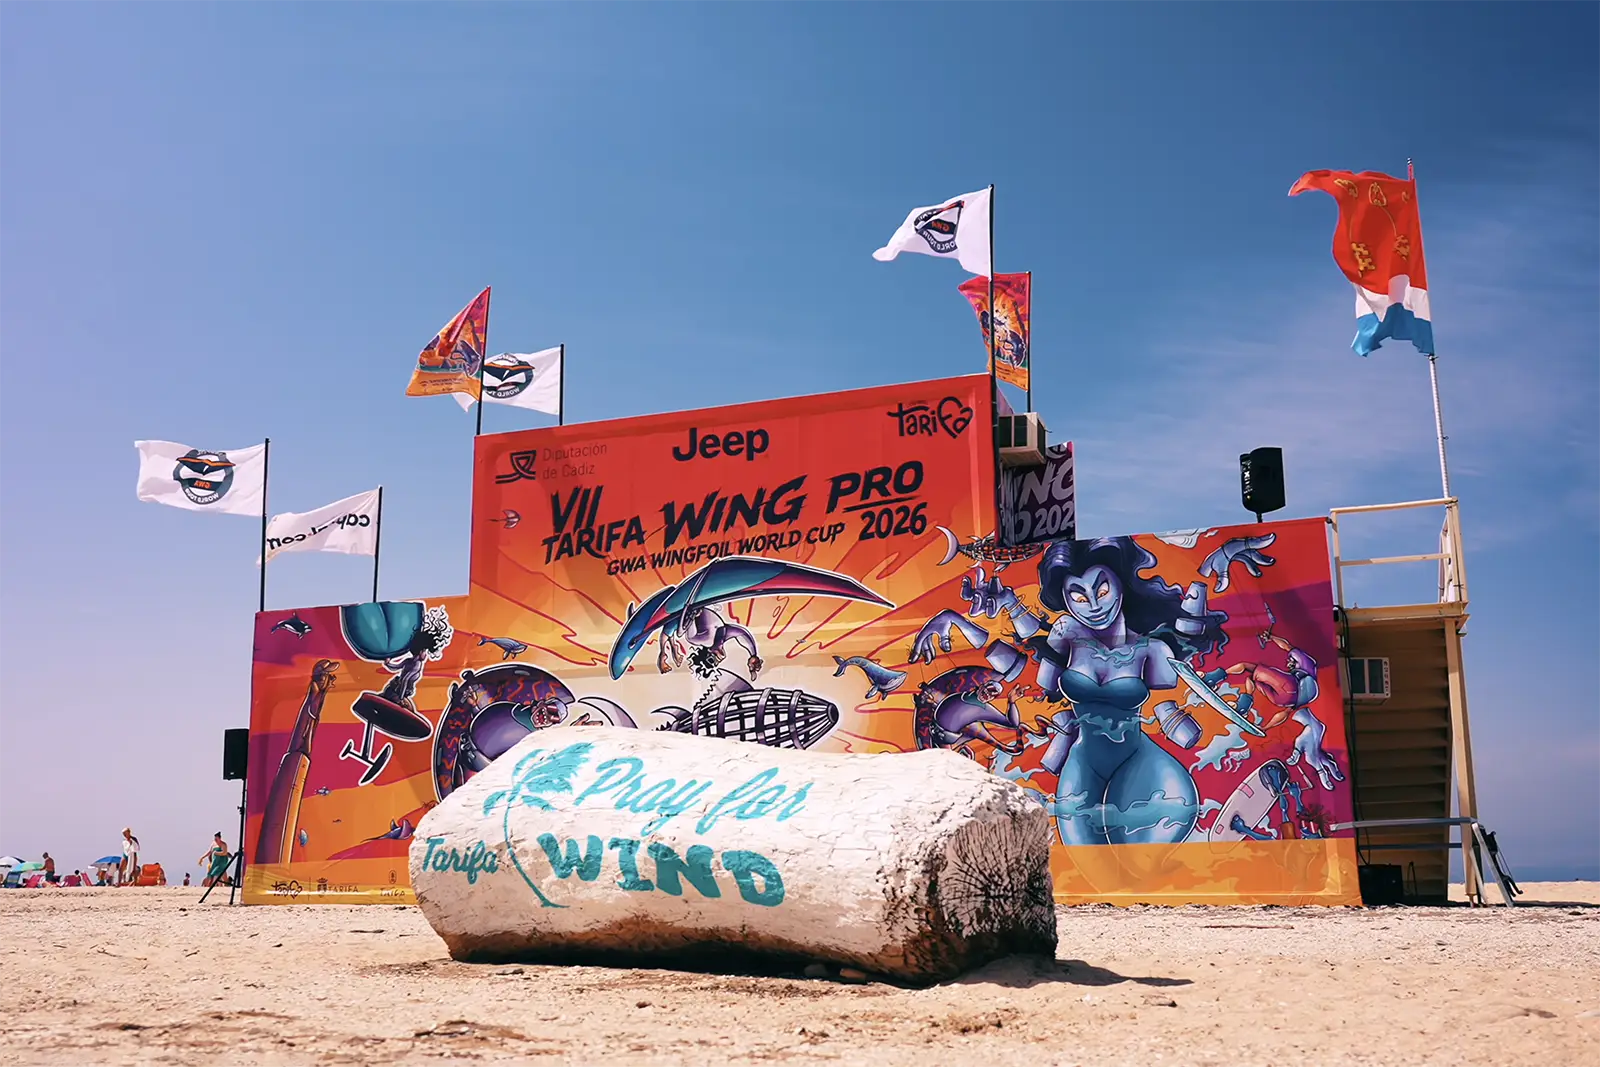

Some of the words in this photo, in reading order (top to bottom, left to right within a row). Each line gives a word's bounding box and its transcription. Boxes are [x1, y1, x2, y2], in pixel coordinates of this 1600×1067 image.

[543, 444, 607, 461] Diputación
[672, 428, 770, 461] Jeep
[543, 467, 556, 479] de
[541, 515, 646, 564] TARIFA
[661, 475, 809, 549] WING
[826, 460, 923, 511] PRO
[551, 486, 604, 535] VII
[858, 501, 928, 541] 2026
[1033, 500, 1074, 538] 202
[607, 556, 646, 577] GWA
[649, 541, 735, 570] WINGFOIL
[738, 527, 800, 556] WORLD
[807, 521, 846, 545] CUP
[572, 756, 713, 837] Pray
[695, 767, 815, 836] for
[421, 837, 499, 885] Tarifa
[537, 833, 785, 907] WIND
[328, 885, 359, 893] TARIFA
